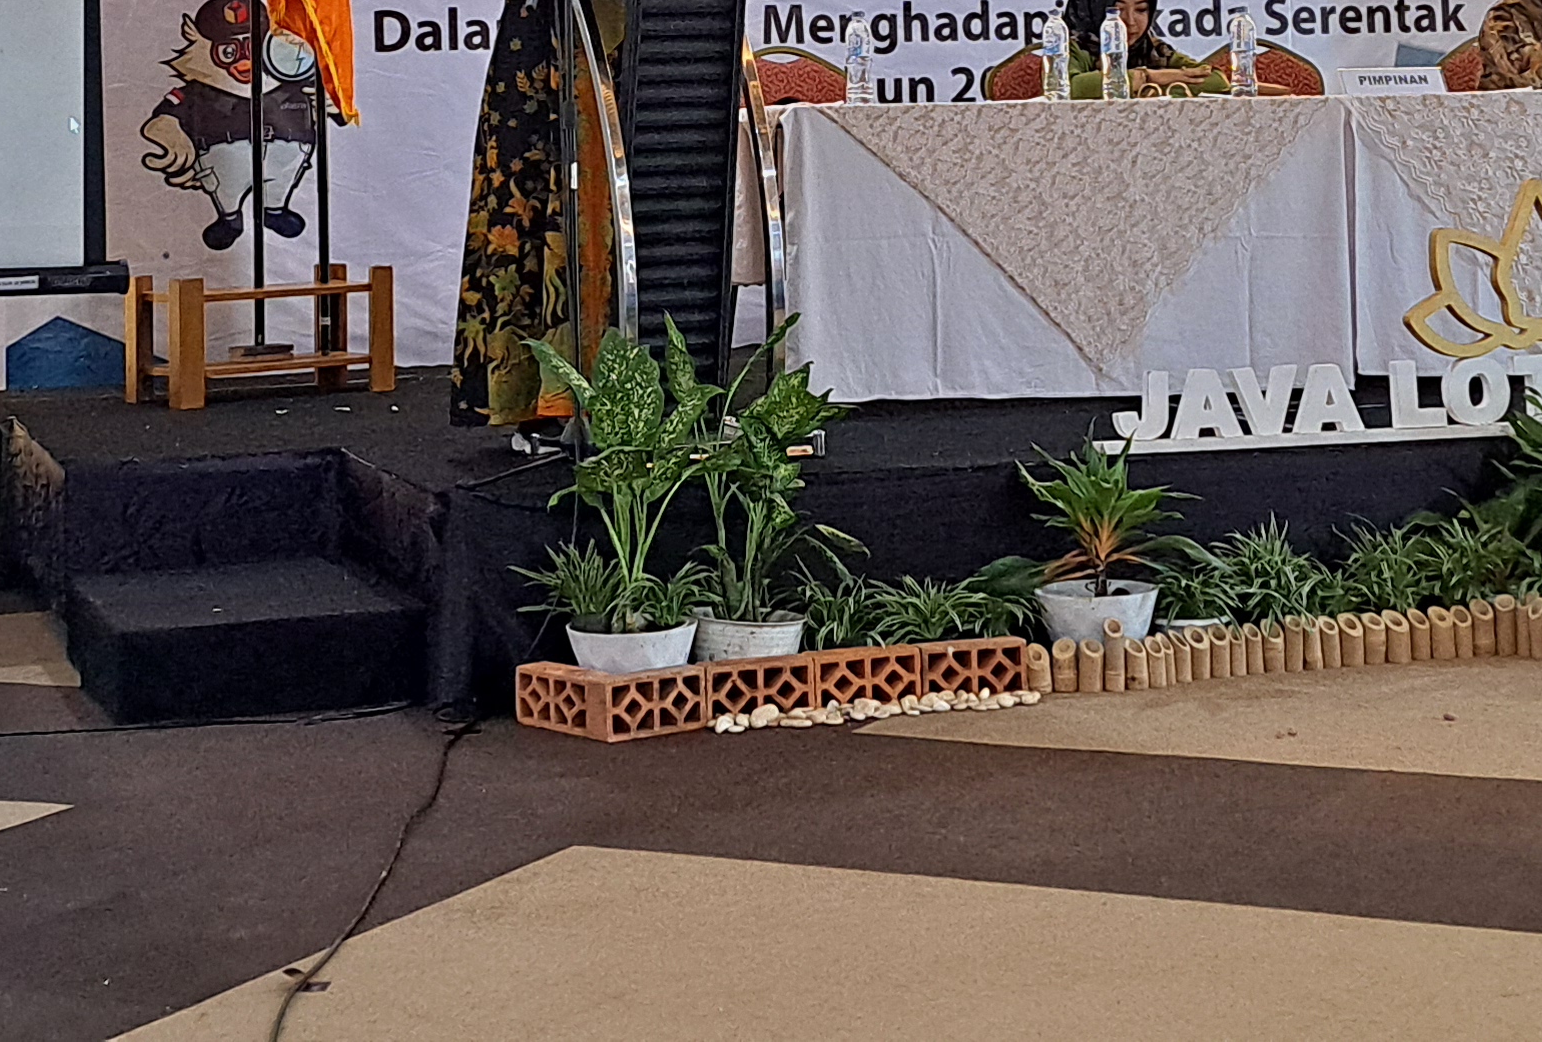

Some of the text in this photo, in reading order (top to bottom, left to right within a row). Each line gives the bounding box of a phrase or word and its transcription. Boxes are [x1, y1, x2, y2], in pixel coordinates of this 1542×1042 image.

[374, 6, 500, 53] Dala
[1357, 74, 1429, 87] PIMPINAN
[1112, 363, 1366, 441] JAVA
